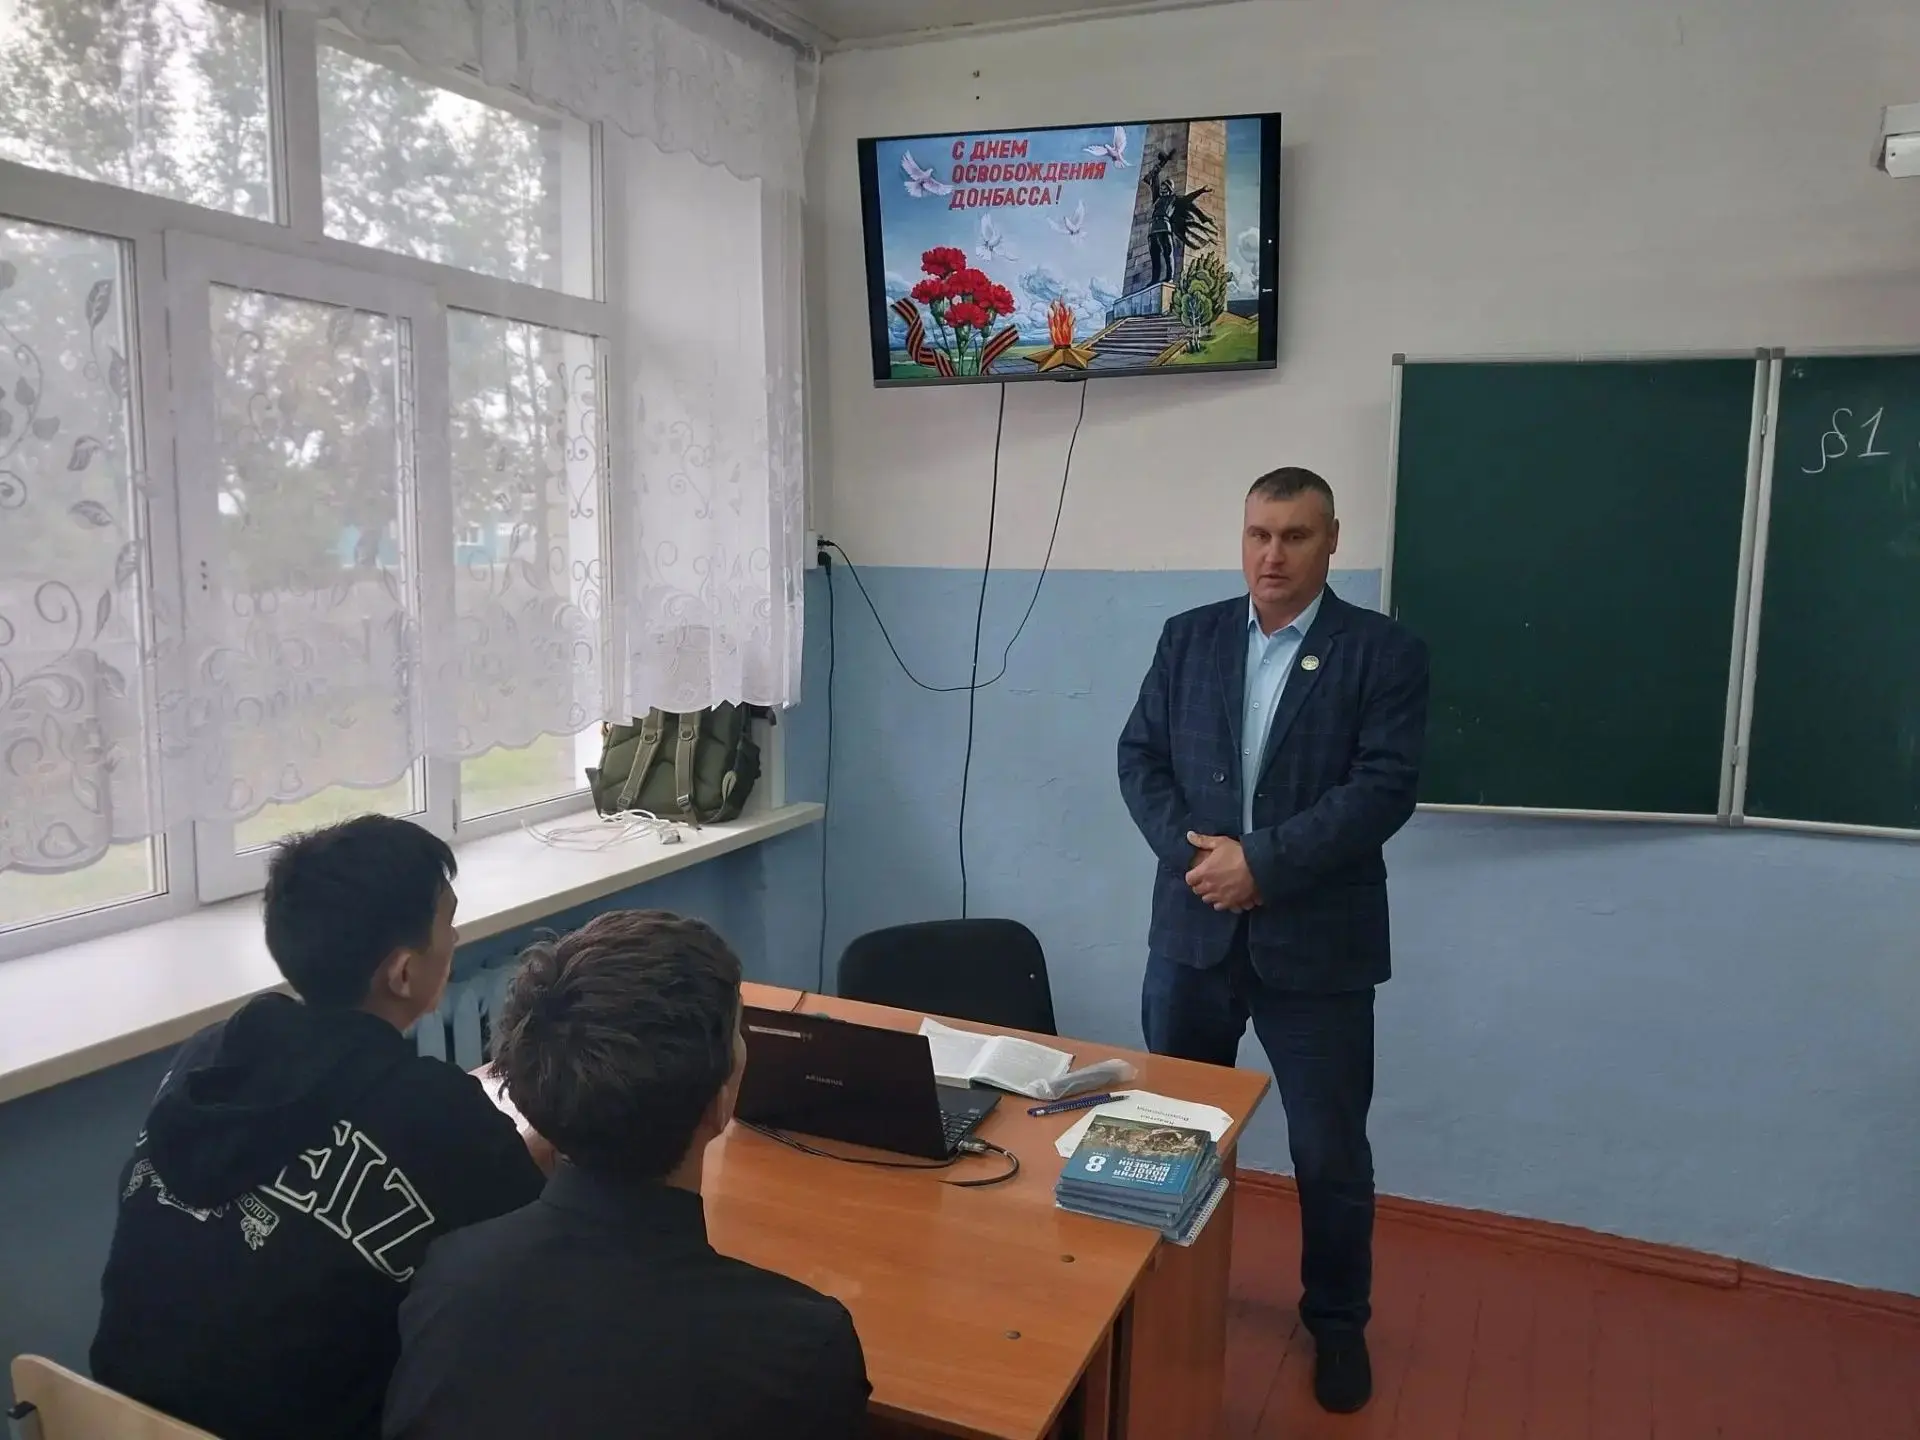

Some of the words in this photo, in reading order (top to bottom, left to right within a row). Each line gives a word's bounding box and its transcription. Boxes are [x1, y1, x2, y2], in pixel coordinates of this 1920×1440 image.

[952, 141, 965, 160] С
[970, 139, 1028, 161] ДНЕМ
[952, 161, 1107, 184] ОСВОБОЖДЕНИЯ
[949, 185, 1062, 210] ДОНБАССА!
[1085, 1155, 1107, 1172] 8
[1112, 1169, 1167, 1182] ИСТОРИЯ
